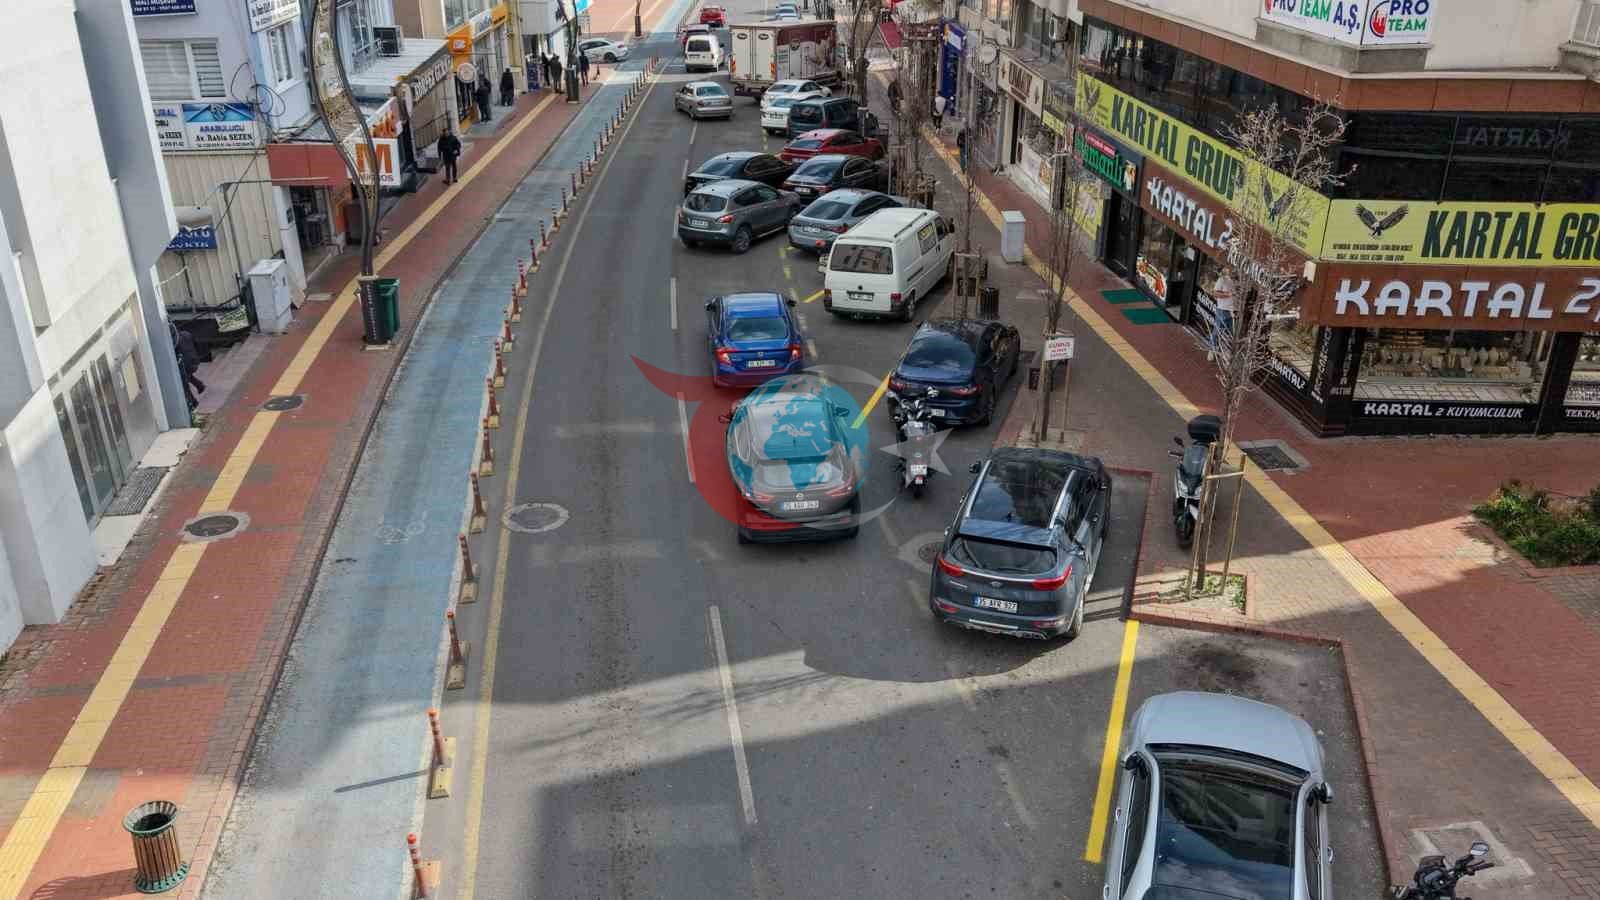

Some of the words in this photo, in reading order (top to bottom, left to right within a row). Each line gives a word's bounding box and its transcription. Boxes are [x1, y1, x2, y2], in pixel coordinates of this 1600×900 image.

[1300, 0, 1331, 22] TEAM
[1390, 0, 1429, 16] PRO
[1388, 17, 1428, 32] TEAM
[1111, 94, 1179, 167] KARTAL
[1147, 176, 1216, 248] KARTAL
[1421, 210, 1546, 259] KARTAL
[1553, 212, 1600, 260] GR
[1335, 279, 1553, 319] KARTAL
[1364, 402, 1432, 416] KARTAL
[1447, 406, 1524, 418] KUYUMCULUK
